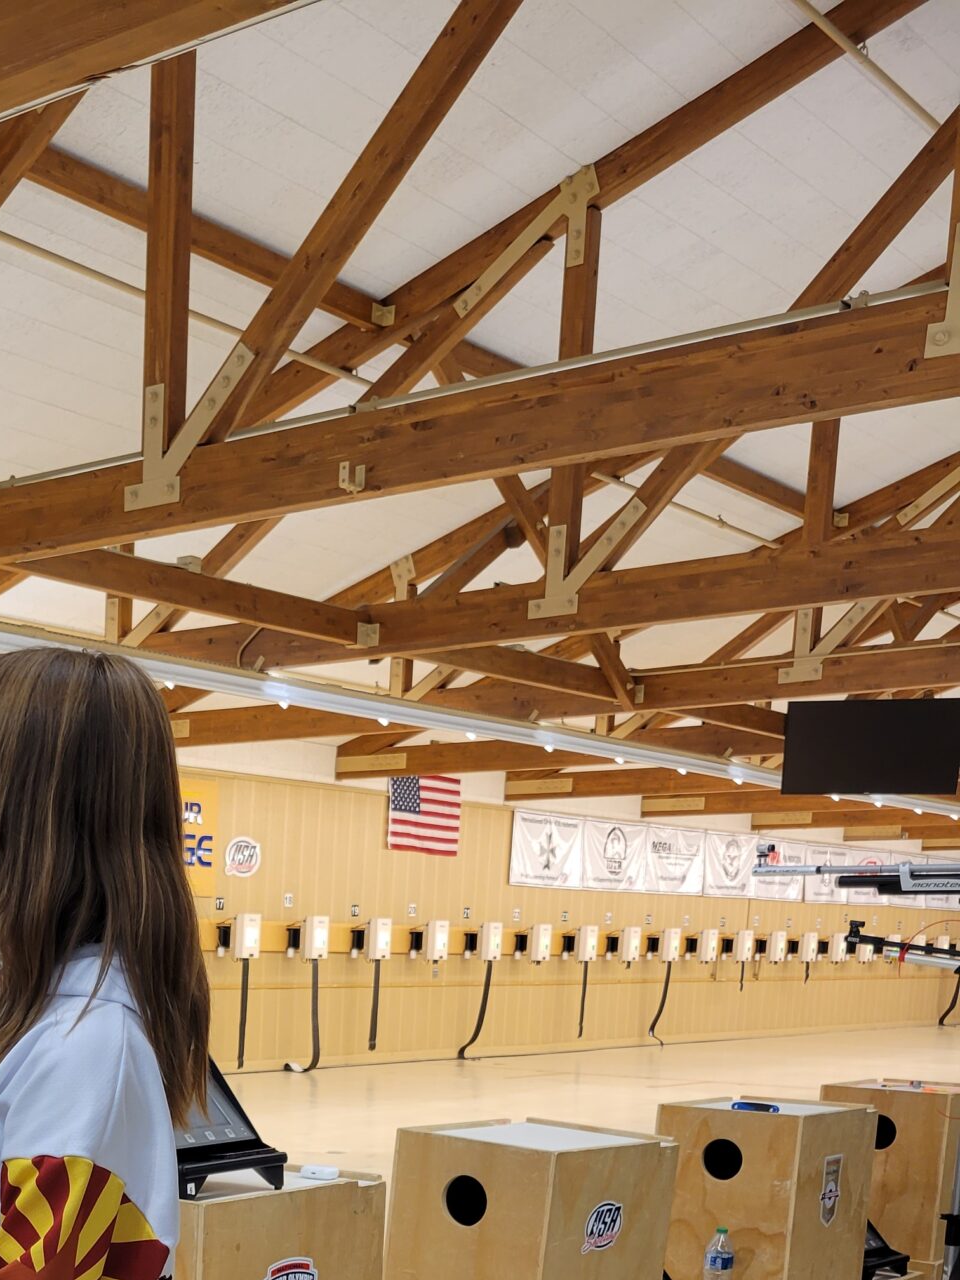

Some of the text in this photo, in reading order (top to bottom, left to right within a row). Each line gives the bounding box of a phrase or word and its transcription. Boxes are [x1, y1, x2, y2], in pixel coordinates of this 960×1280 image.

[231, 844, 257, 865] USA
[216, 898, 224, 909] 17
[351, 905, 359, 916] 19
[589, 1205, 622, 1238] USA
